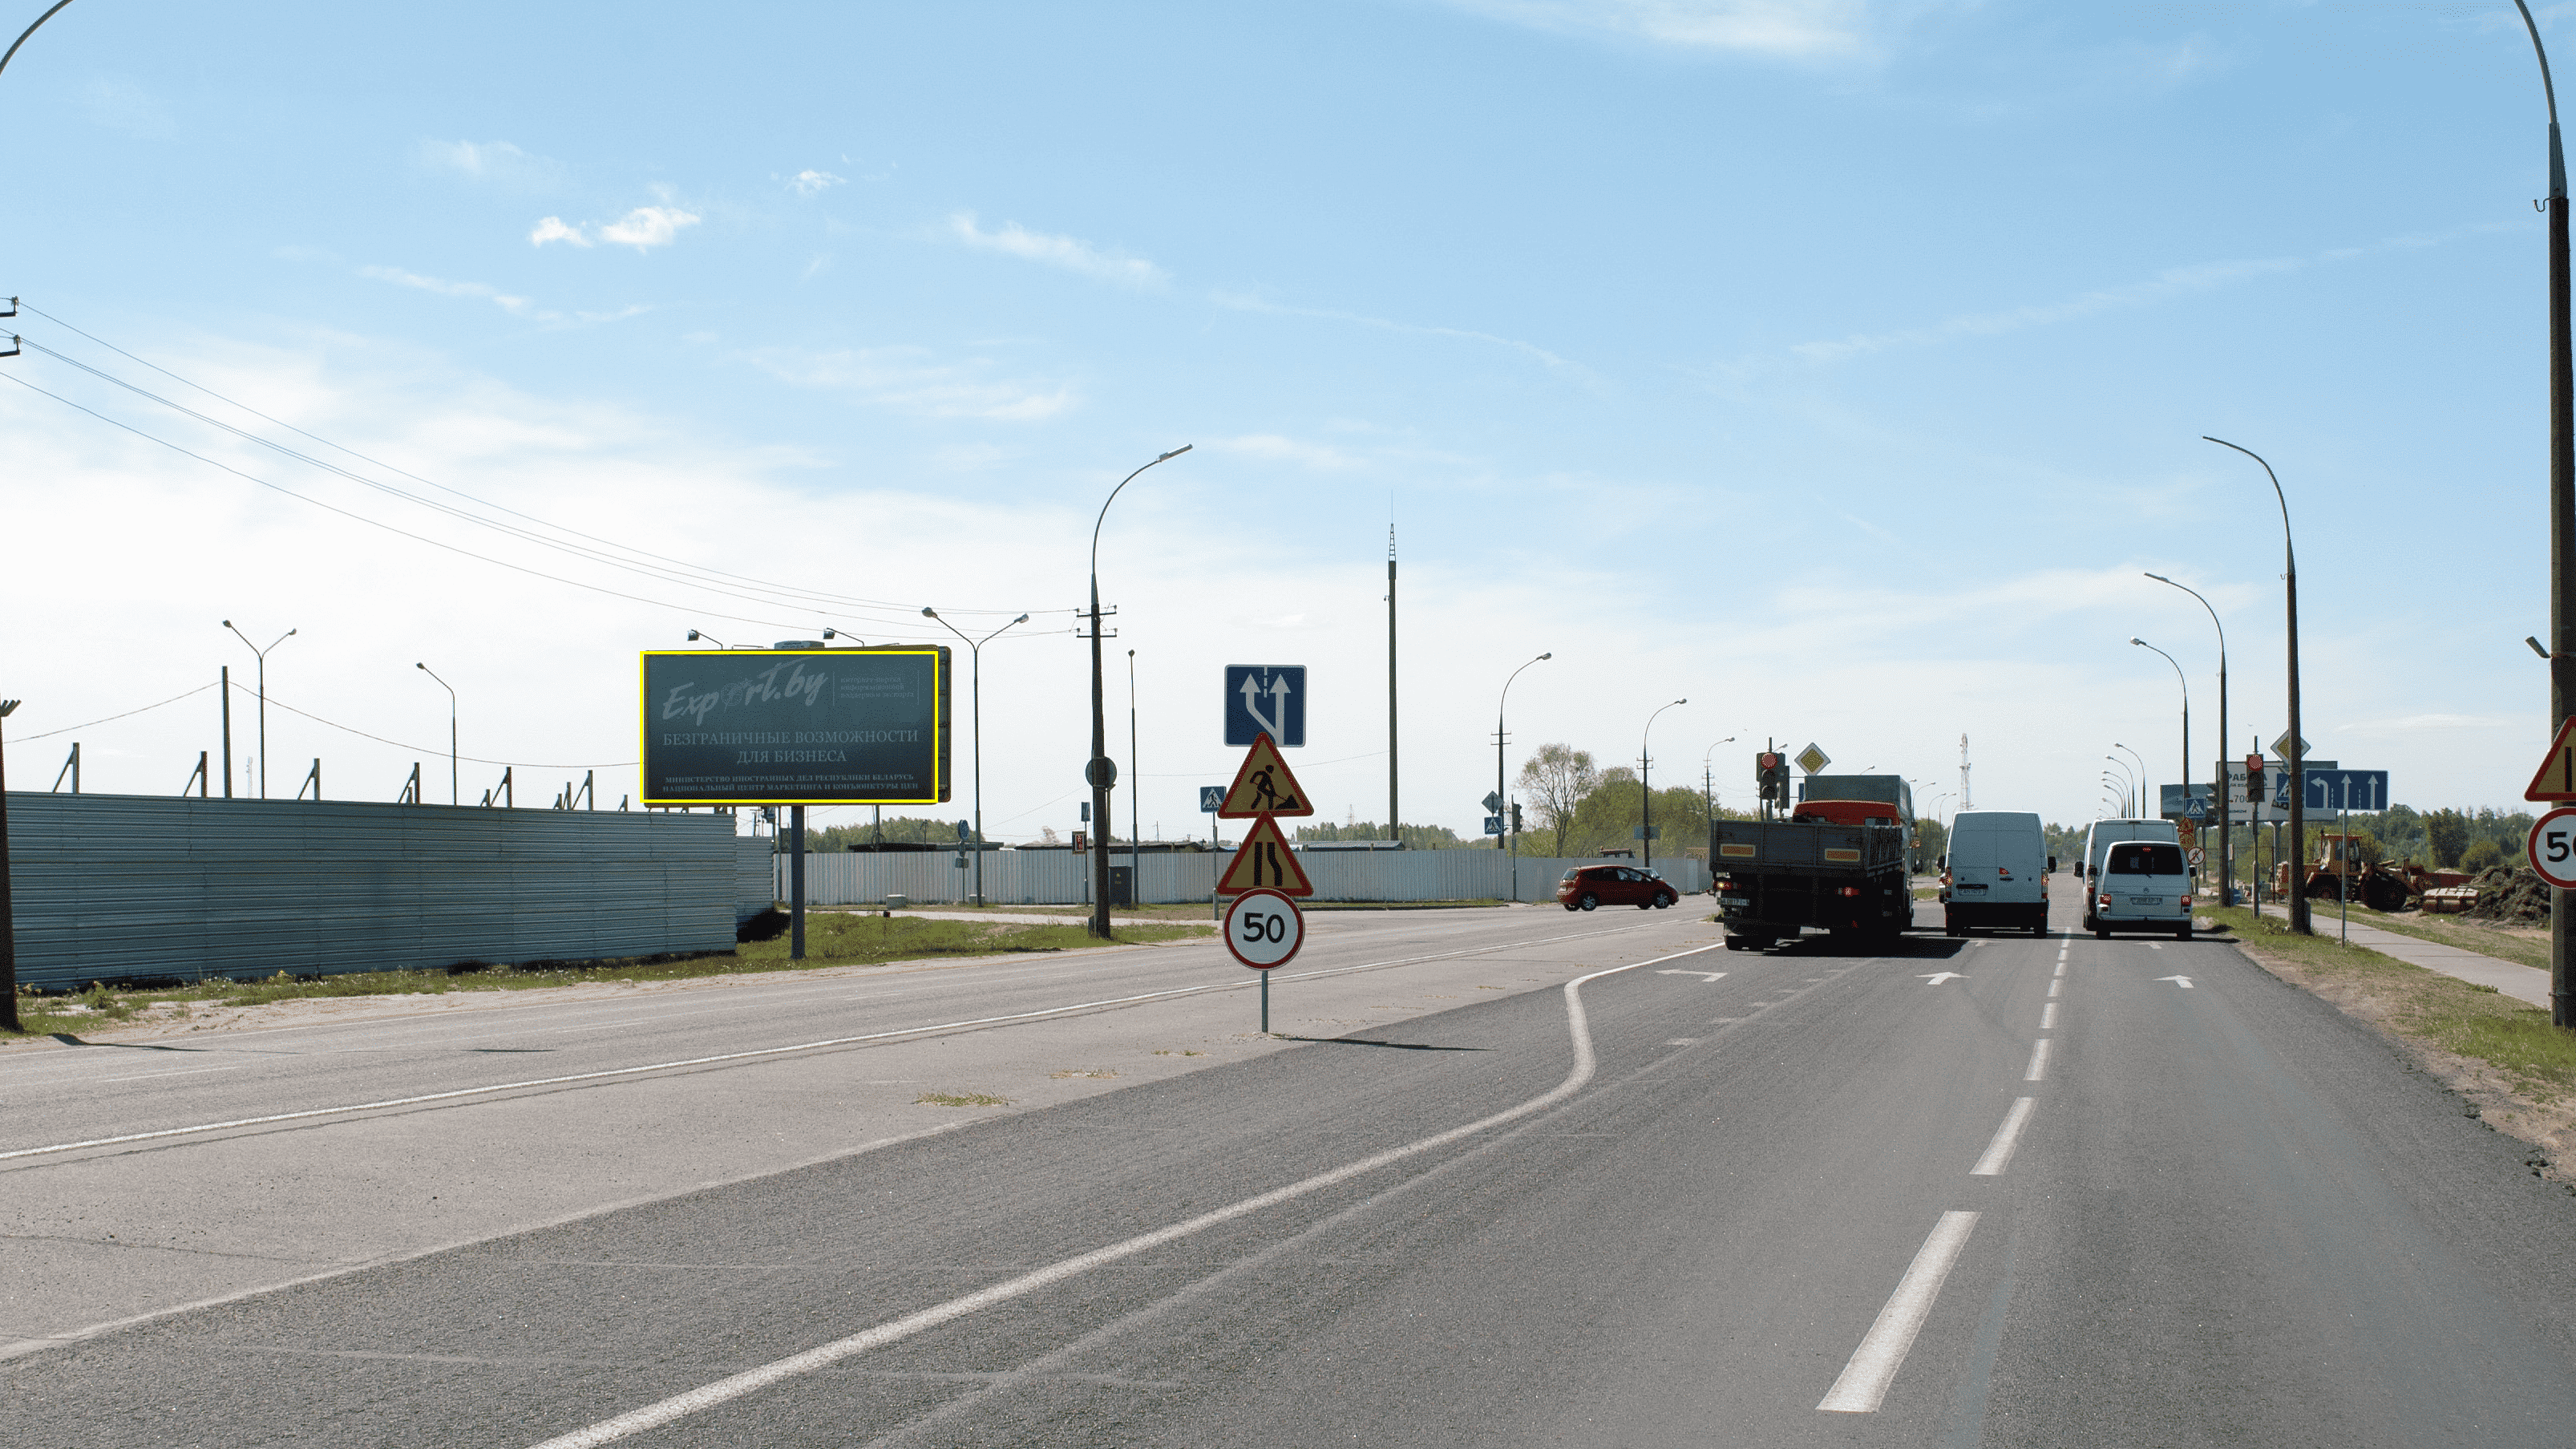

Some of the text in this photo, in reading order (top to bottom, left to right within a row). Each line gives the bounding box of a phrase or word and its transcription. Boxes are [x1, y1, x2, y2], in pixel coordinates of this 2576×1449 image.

[663, 730, 919, 746] БЕЗГРАНИЧНЫЕ ВОЗМОЖНОСТИ
[737, 749, 847, 765] ДЛЯ БИЗНЕСА
[665, 775, 730, 783] МИНИСТЕРСТВО
[795, 774, 814, 783] ДЕЛ
[872, 773, 914, 781] БЕЛАРУСЬ
[662, 783, 735, 793] НАЦИОНАЛЬНЫЙ
[737, 783, 765, 792] ЦЕНТР
[900, 783, 918, 791] ЦЕН
[2546, 832, 2576, 862] 5
[1243, 913, 1286, 943] 50
